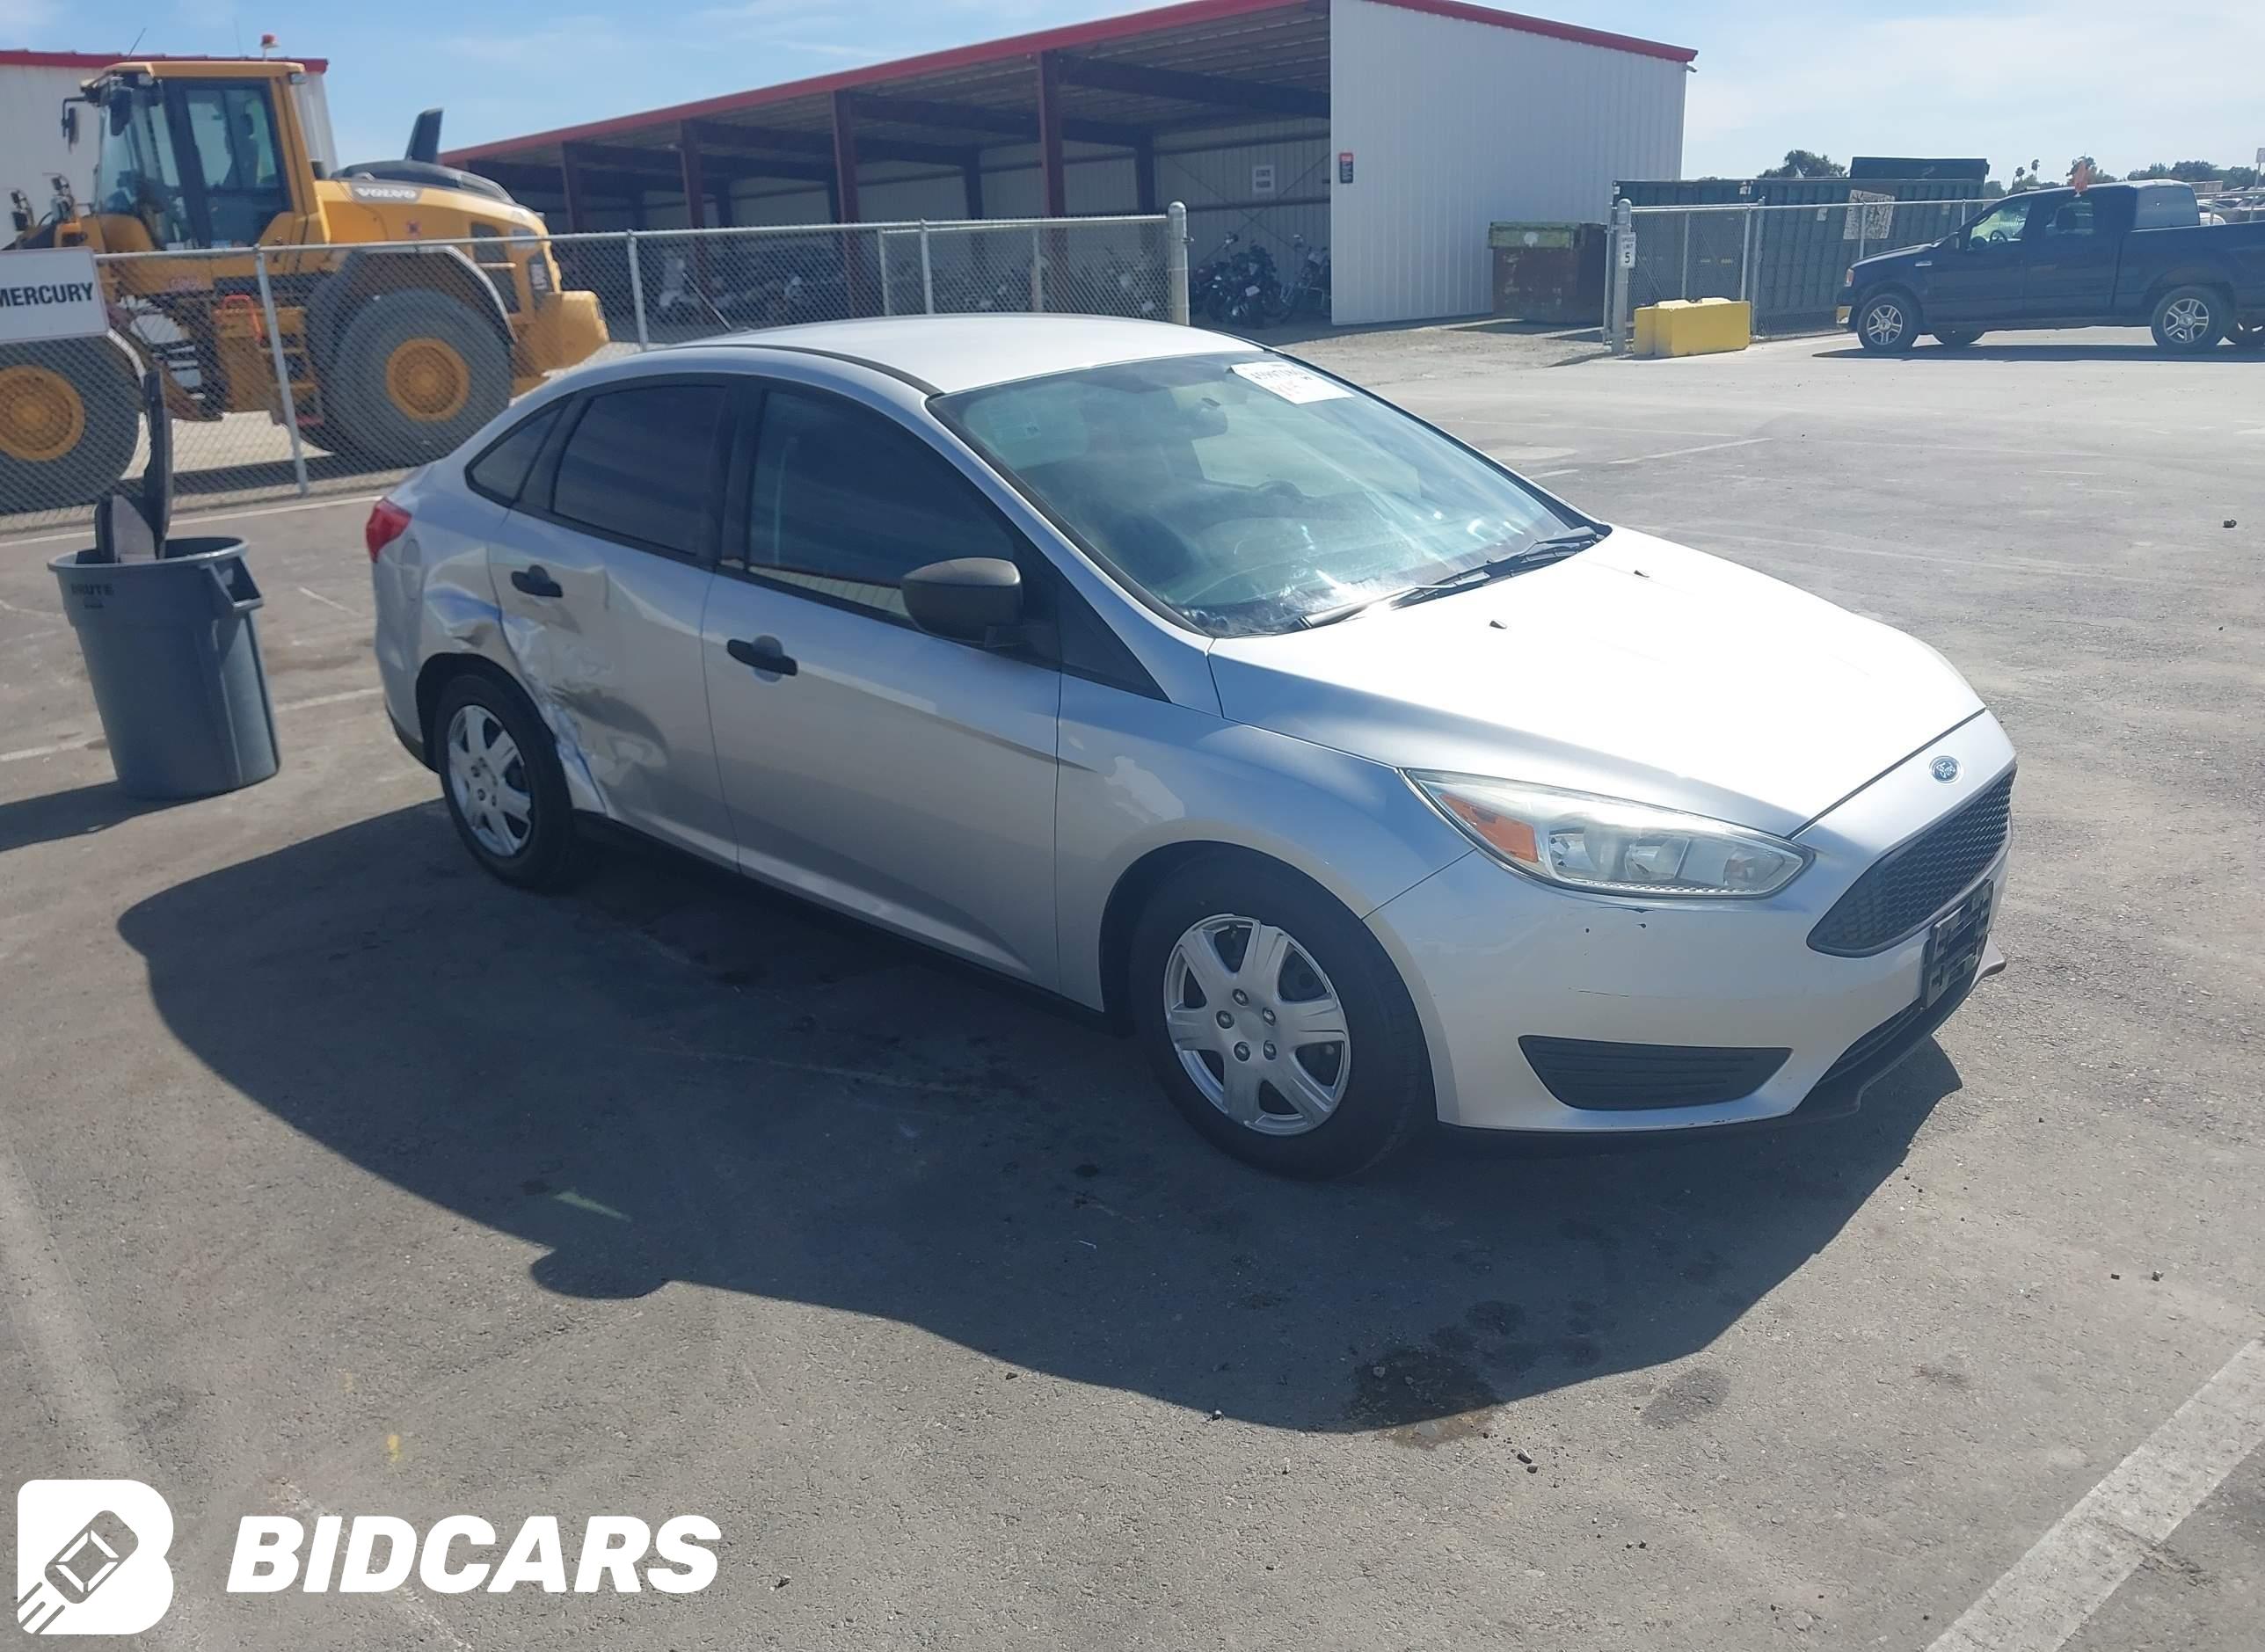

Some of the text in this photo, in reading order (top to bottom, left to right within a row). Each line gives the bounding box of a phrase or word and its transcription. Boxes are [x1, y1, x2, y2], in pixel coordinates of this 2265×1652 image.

[355, 187, 417, 199] VOLVO
[1625, 251, 1631, 264] 5
[0, 282, 92, 307] MERCURY
